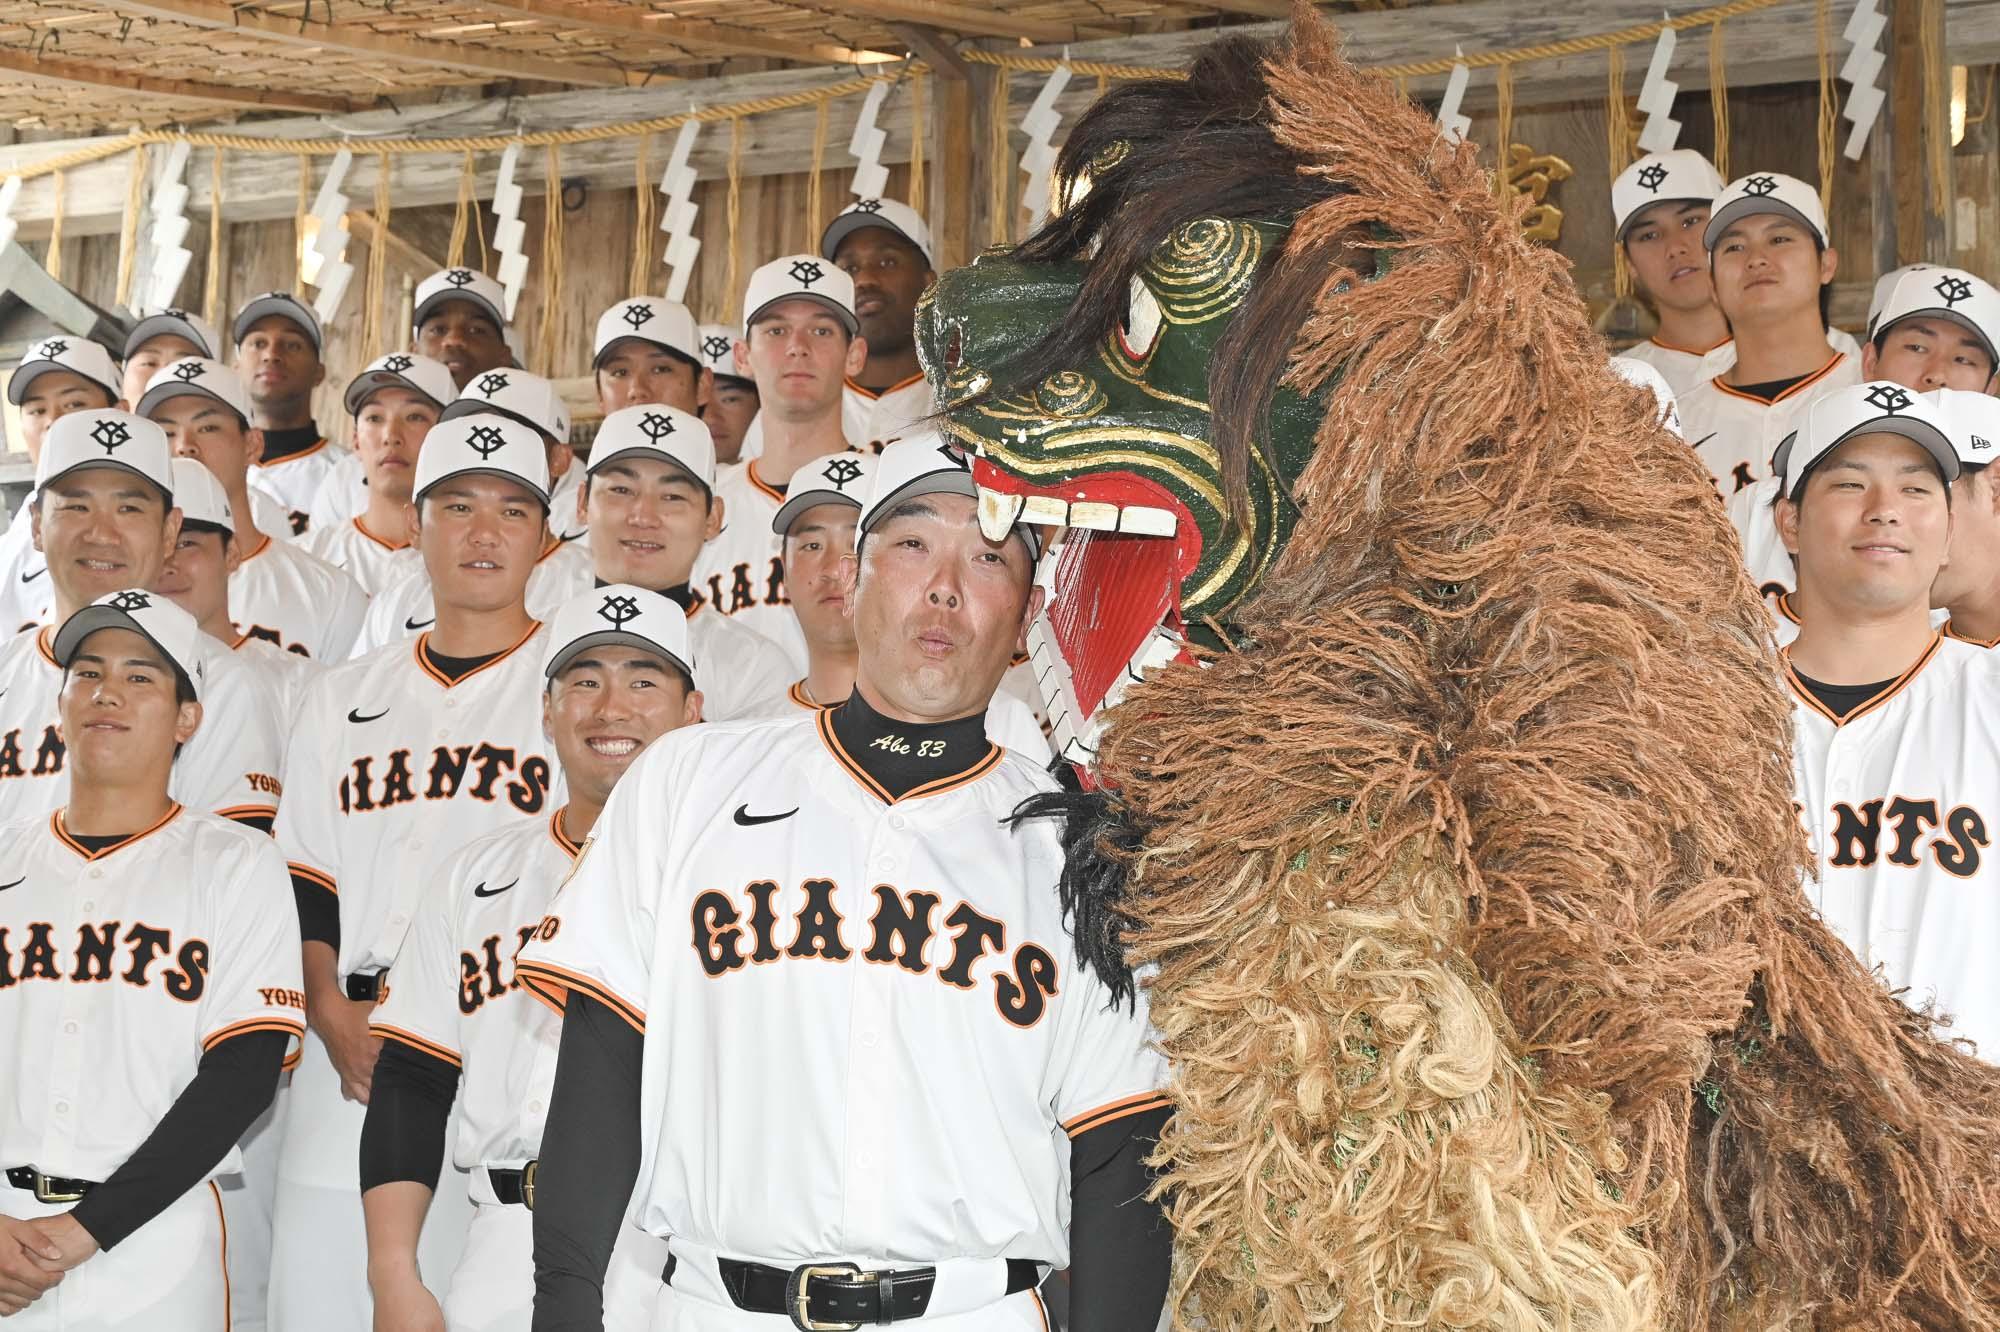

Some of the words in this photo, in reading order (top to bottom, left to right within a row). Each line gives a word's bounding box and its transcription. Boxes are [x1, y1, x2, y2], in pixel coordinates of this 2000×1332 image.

[339, 742, 550, 815] IANTS
[869, 734, 911, 755] Abe
[916, 740, 947, 758] 83
[1794, 795, 1992, 880] NTS
[691, 878, 1060, 1029] GIANTS
